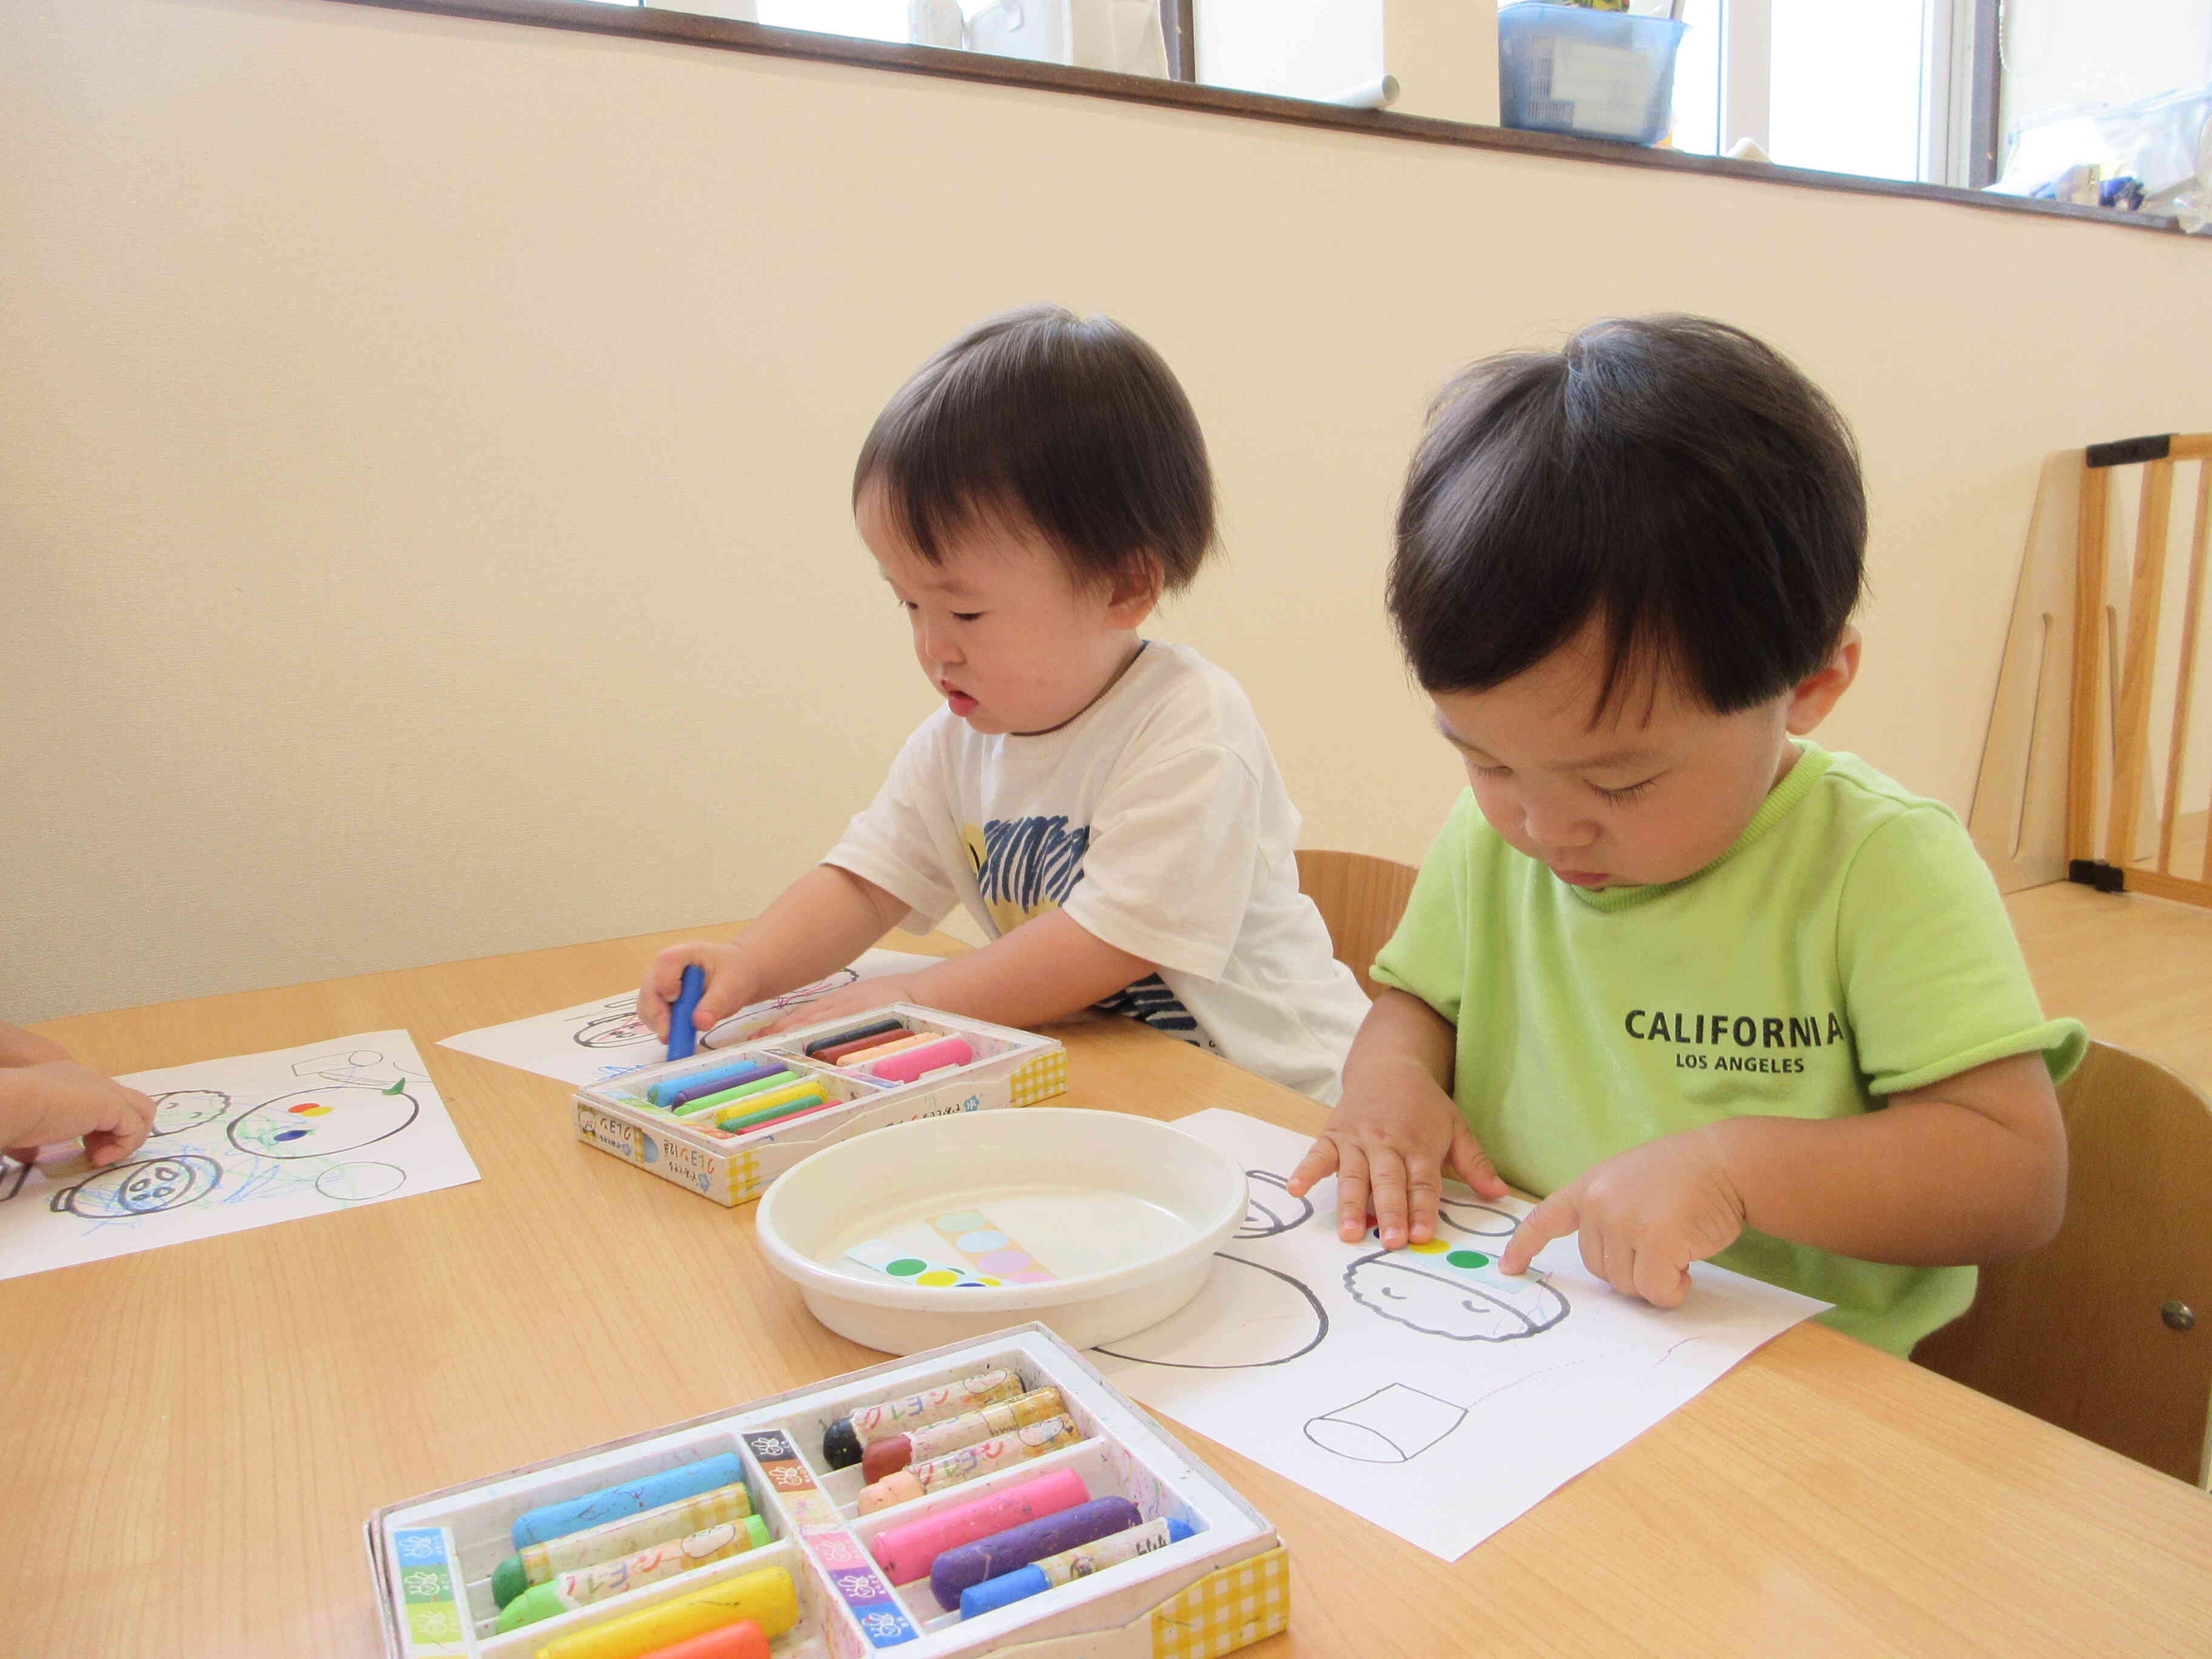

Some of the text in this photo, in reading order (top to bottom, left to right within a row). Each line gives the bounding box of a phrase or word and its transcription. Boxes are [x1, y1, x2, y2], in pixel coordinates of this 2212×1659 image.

[1624, 1010, 1845, 1048] CALIFORNIA
[1676, 1053, 1805, 1073] LOS ANGELES
